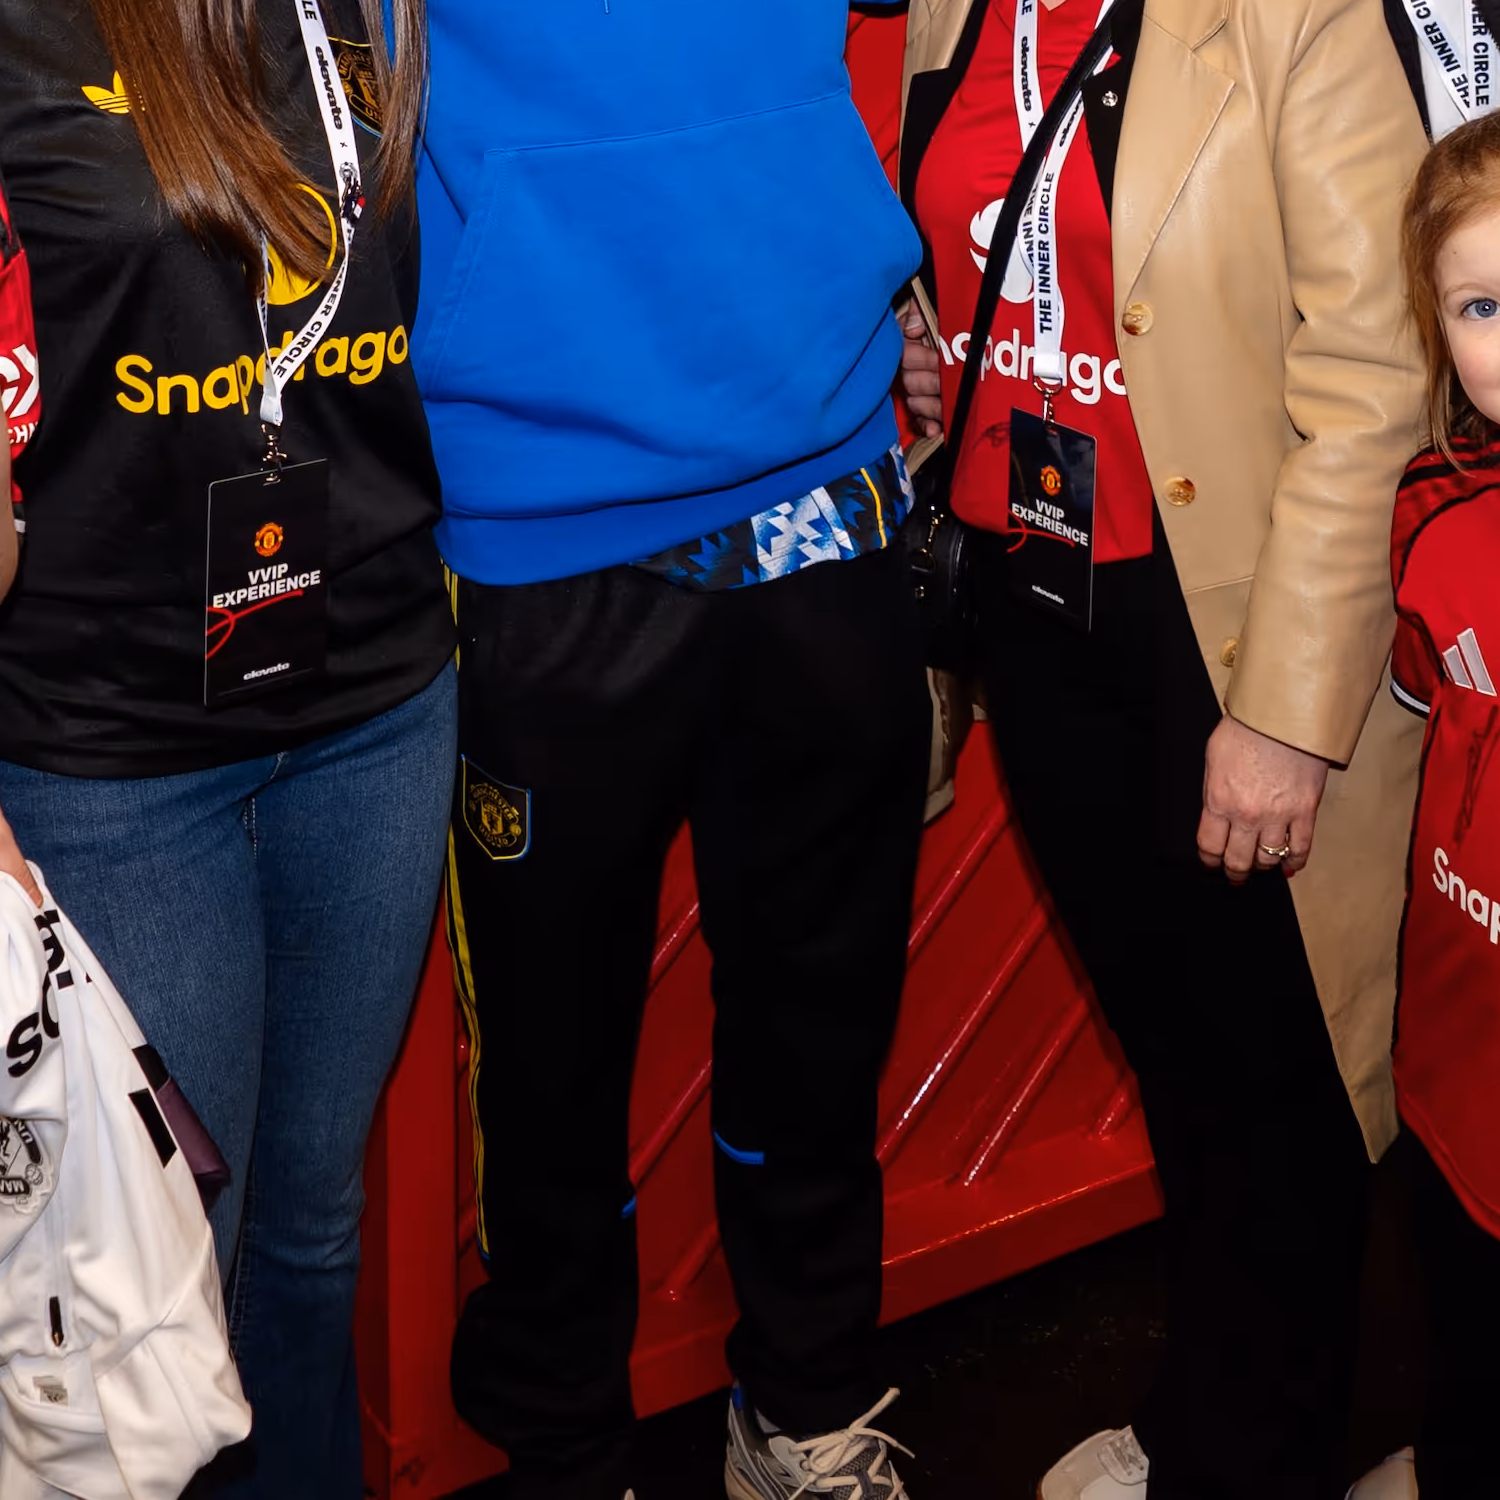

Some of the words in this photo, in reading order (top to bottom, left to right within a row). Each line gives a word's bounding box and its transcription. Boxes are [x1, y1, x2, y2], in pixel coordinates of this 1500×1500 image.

[1423, 21, 1461, 73] INNER
[315, 45, 343, 130] elevate
[1473, 42, 1490, 107] CIRCLE
[1038, 172, 1055, 234] CIRCLE
[1038, 240, 1051, 294] INNER
[1039, 299, 1052, 334] THE
[273, 320, 322, 379] CIRCLE
[1011, 502, 1089, 547] EXPERIENCE
[1035, 498, 1065, 521] VVIP
[212, 569, 321, 609] EXPERIENCE
[247, 563, 289, 585] VVIP
